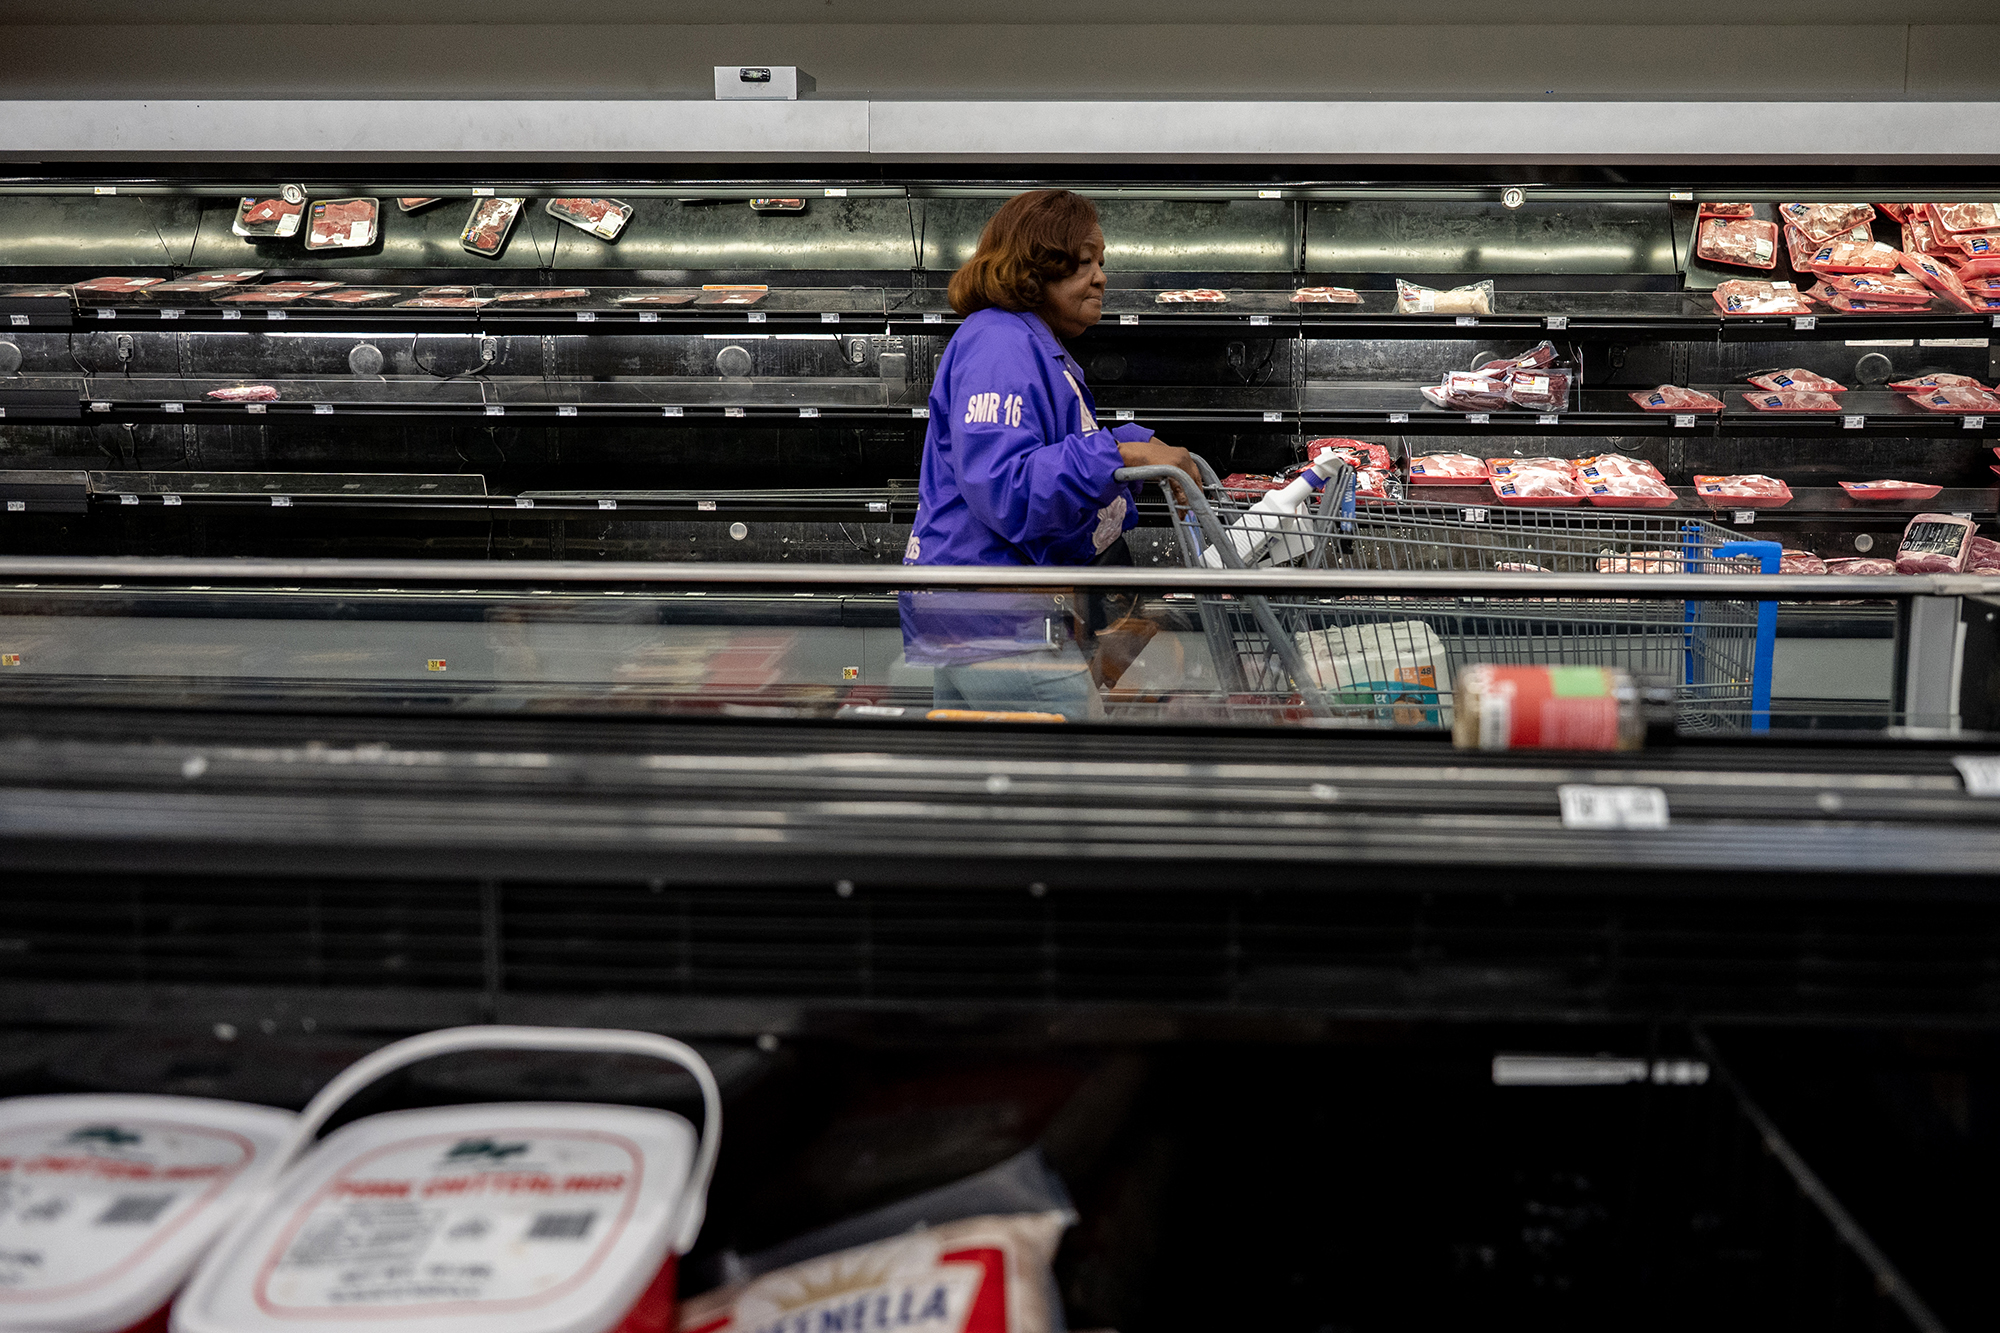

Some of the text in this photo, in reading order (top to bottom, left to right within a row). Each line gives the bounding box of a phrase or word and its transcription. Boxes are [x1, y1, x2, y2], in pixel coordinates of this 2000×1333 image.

[964, 392, 1000, 424] SMR
[1004, 393, 1023, 428] 16
[1420, 667, 1432, 675] 48
[754, 1285, 949, 1333] ENELLA
